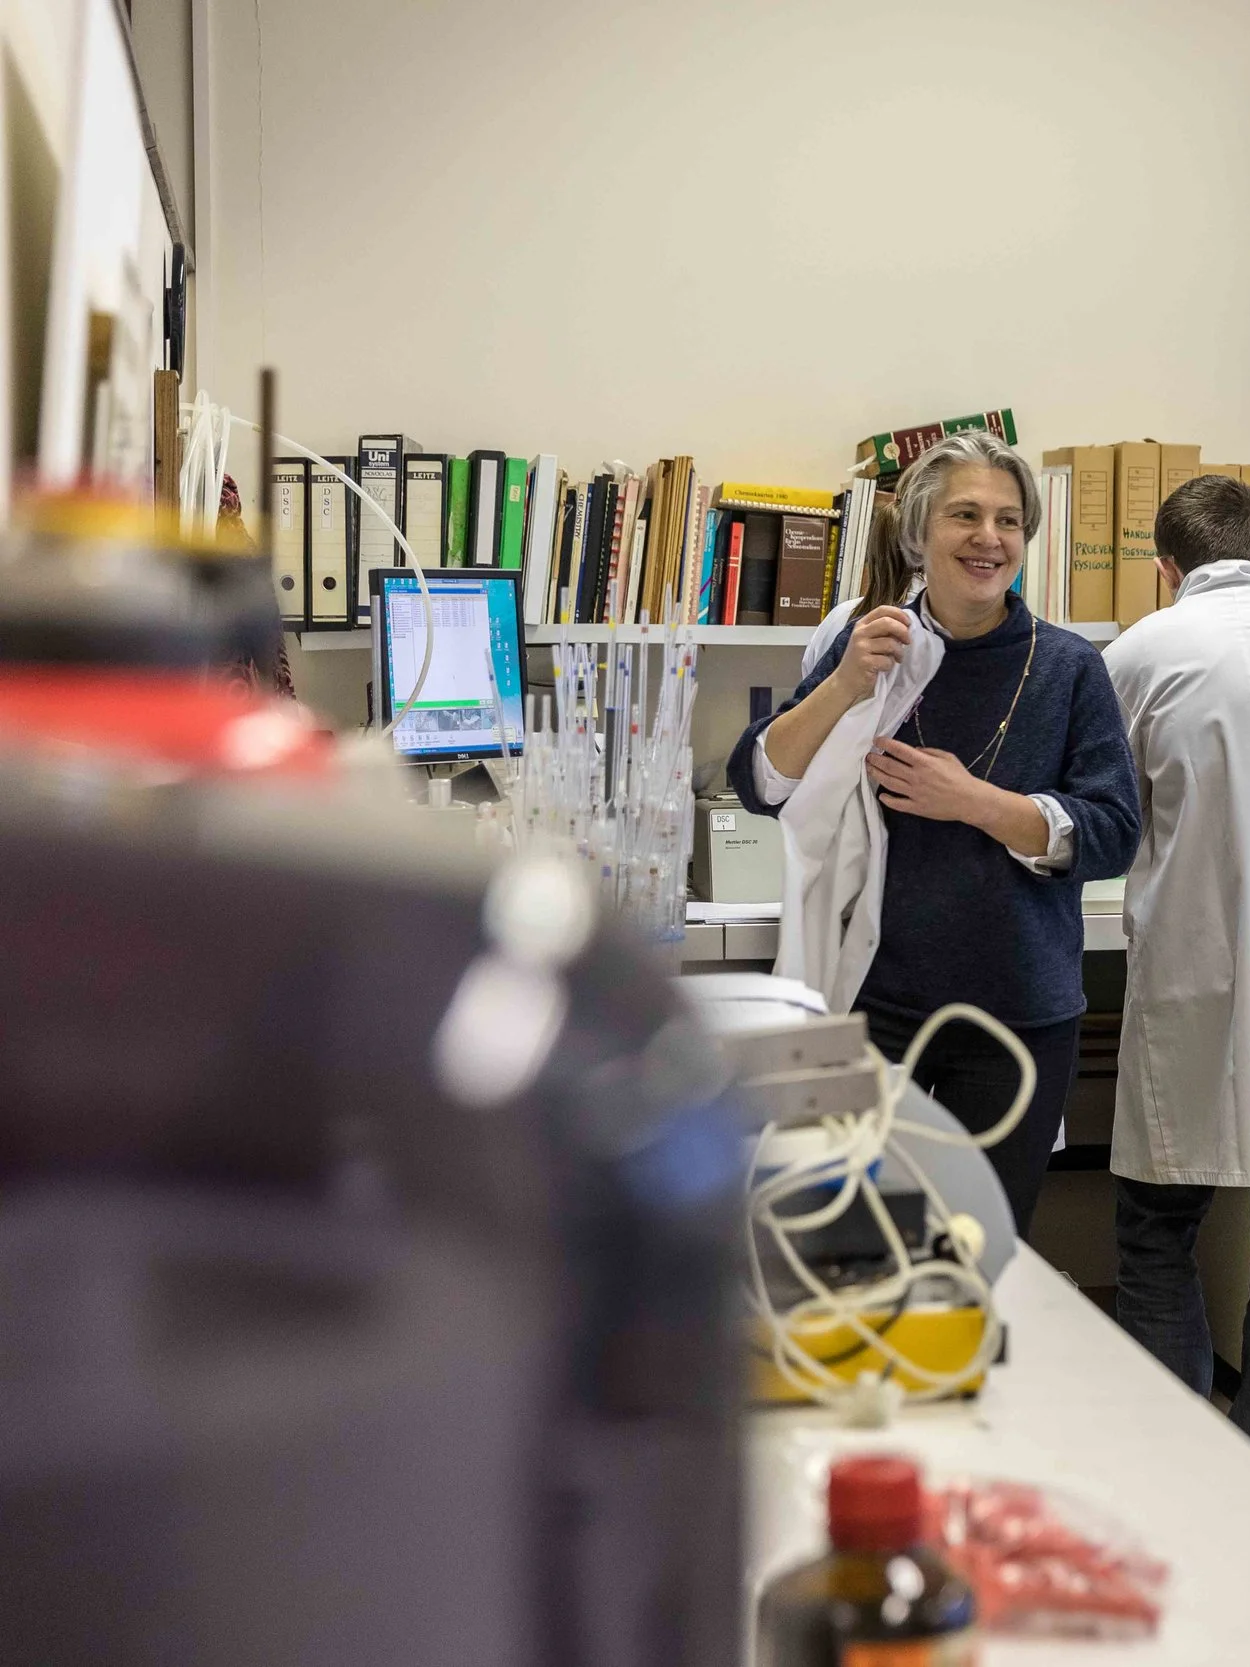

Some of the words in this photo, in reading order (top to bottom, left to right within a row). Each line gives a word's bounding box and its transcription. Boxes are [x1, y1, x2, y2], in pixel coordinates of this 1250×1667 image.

[368, 450, 390, 462] Uni
[413, 472, 436, 480] LEITZ
[323, 488, 331, 515] DSC
[575, 493, 584, 539] CHEMISTRY
[1075, 542, 1114, 556] PROEVEN
